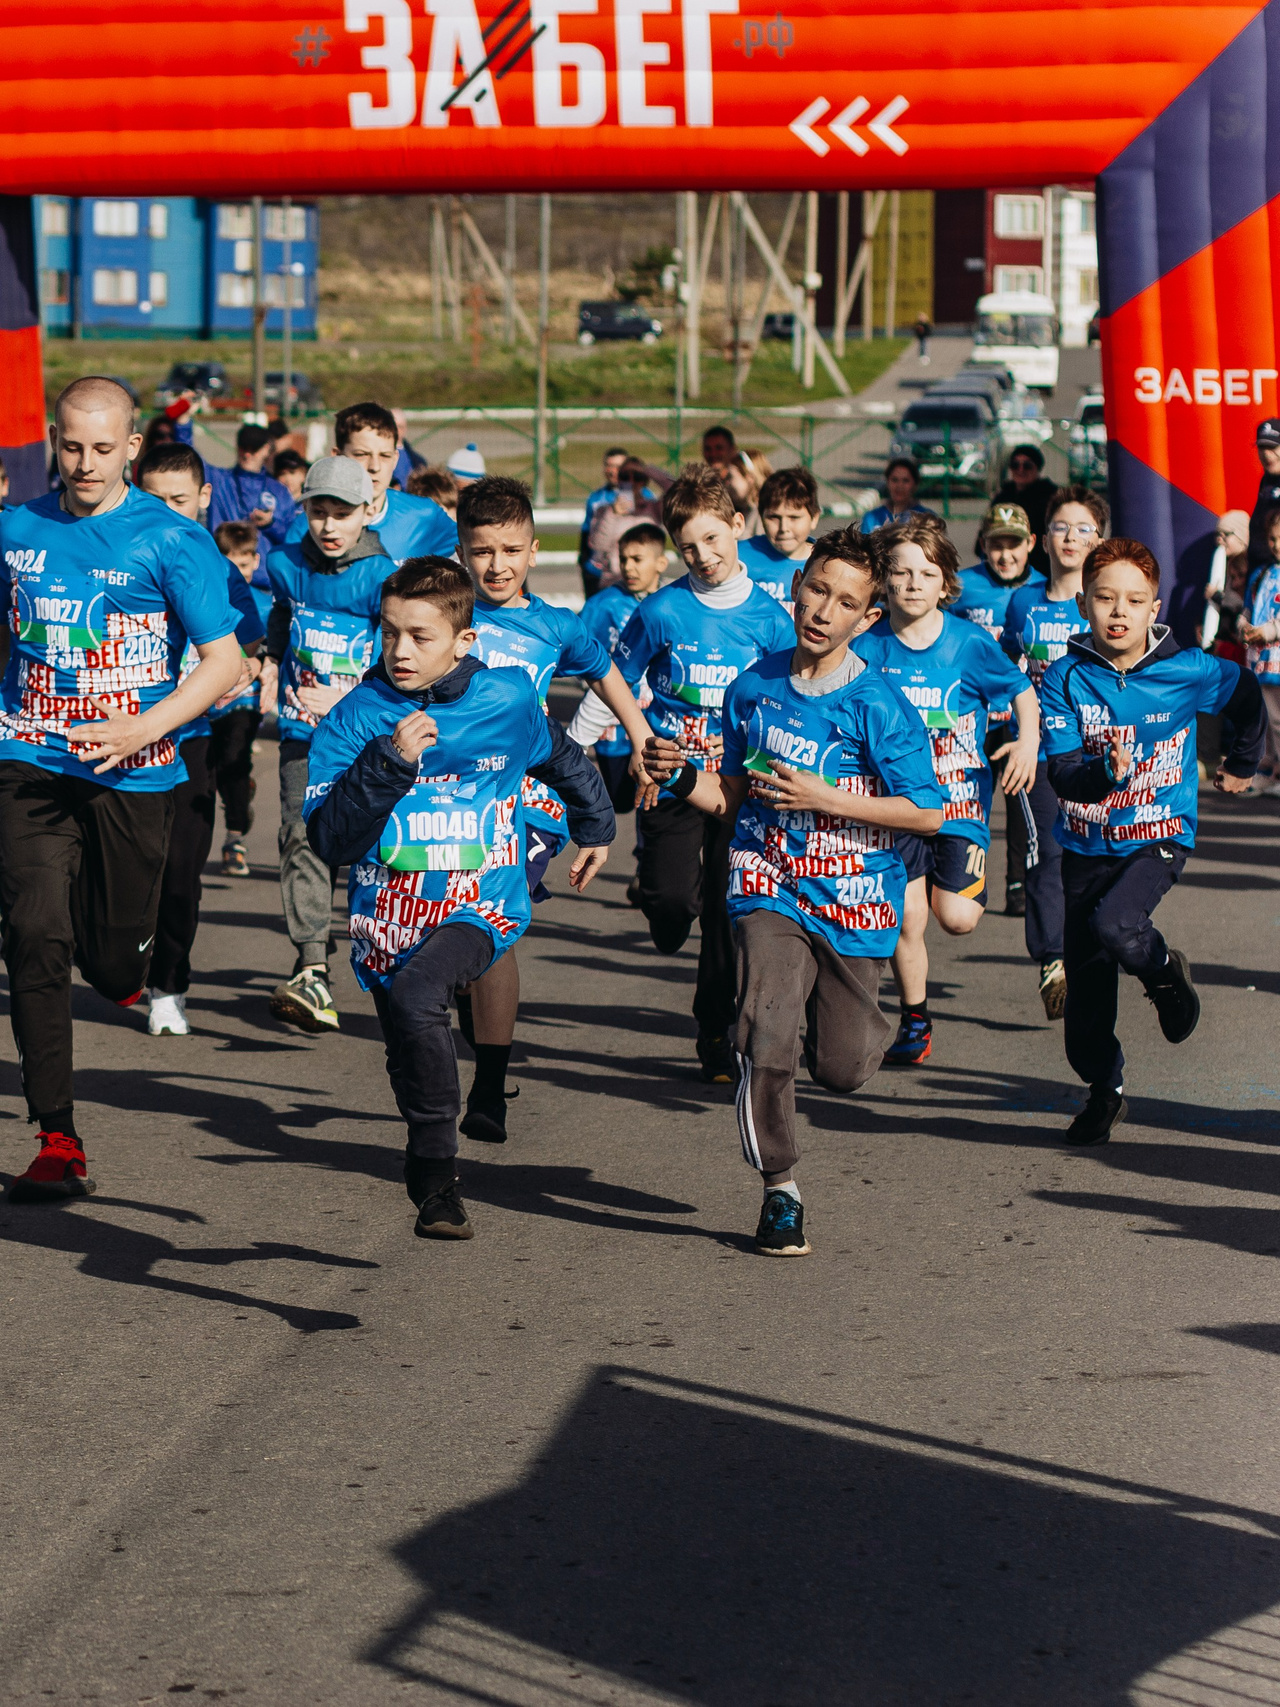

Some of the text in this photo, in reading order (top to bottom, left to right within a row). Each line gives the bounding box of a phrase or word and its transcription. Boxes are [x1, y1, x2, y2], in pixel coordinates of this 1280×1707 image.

[1134, 366, 1279, 406] ЗАБЕГ
[5, 549, 47, 574] 2024
[34, 596, 83, 624] 10027
[766, 725, 819, 766] 10023
[407, 810, 478, 841] 10046
[1134, 804, 1172, 824] 2024
[805, 827, 894, 857] #МОМЕН
[965, 844, 986, 879] 10
[836, 873, 885, 906] 2024
